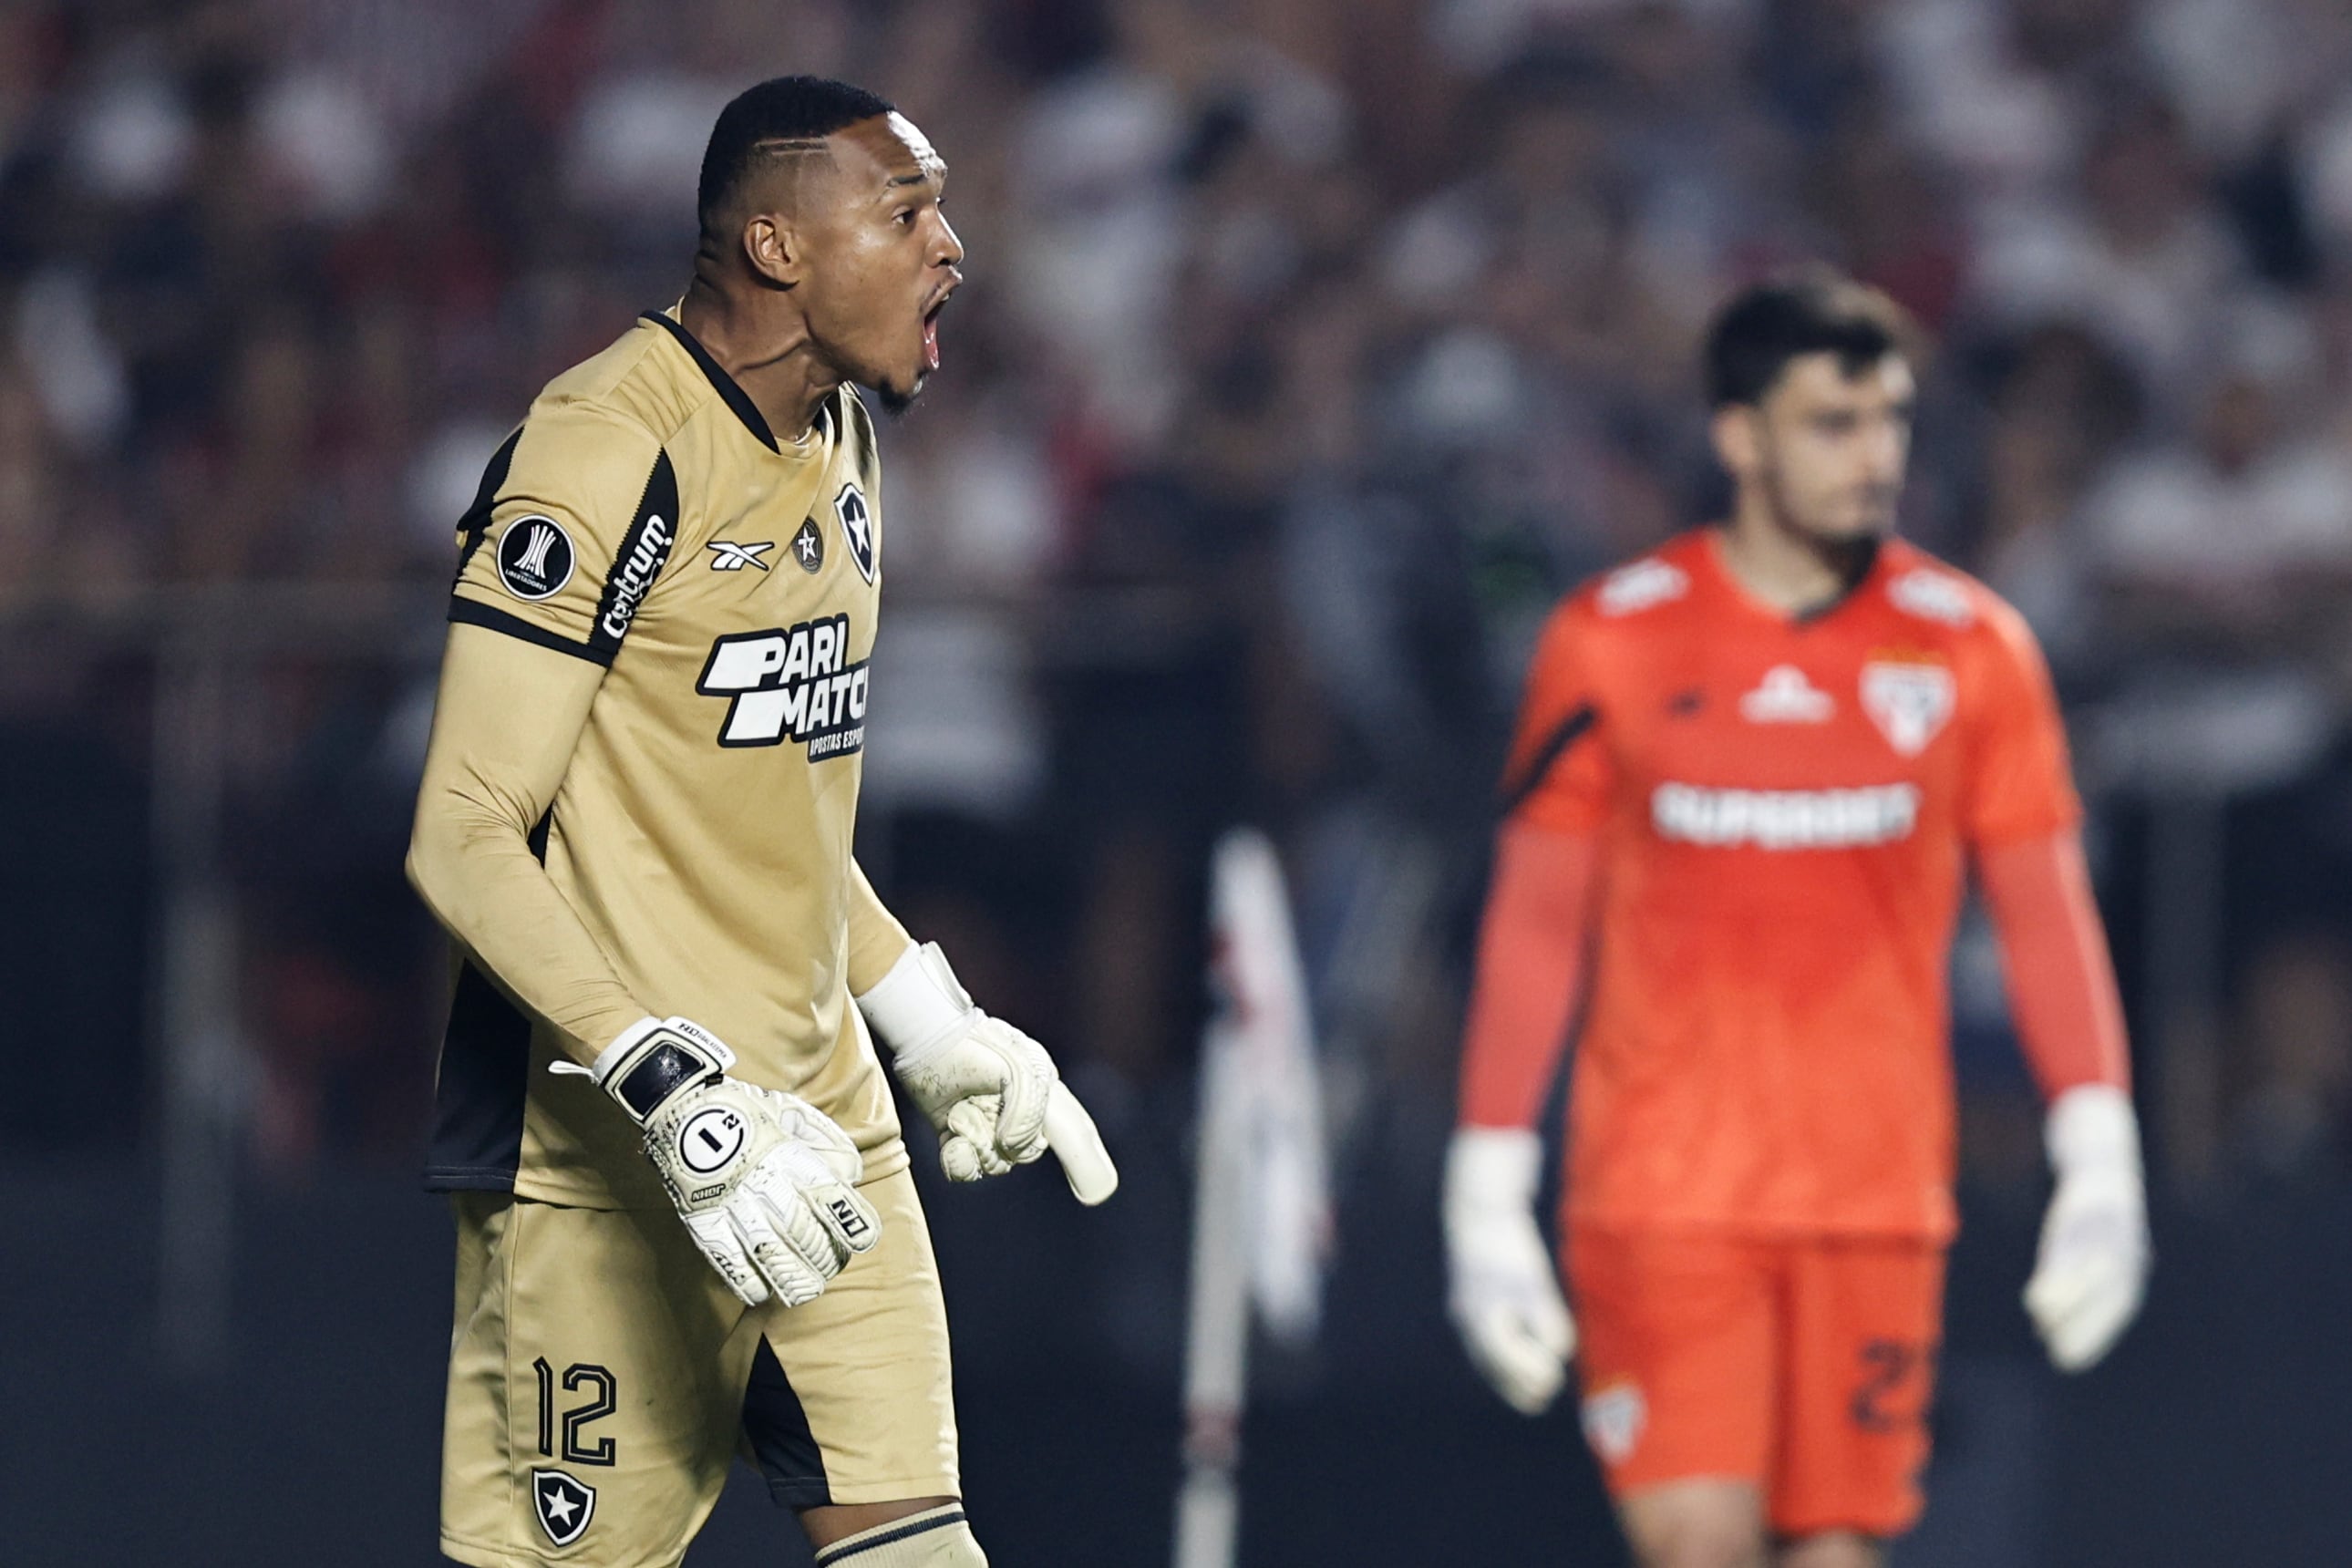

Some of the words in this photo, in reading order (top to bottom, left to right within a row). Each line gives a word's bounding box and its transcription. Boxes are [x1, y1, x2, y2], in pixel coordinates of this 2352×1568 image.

[504, 568, 547, 592] LIBERTADORES
[703, 620, 847, 690] PARI
[725, 665, 870, 740] MATC
[532, 1356, 616, 1467] 12
